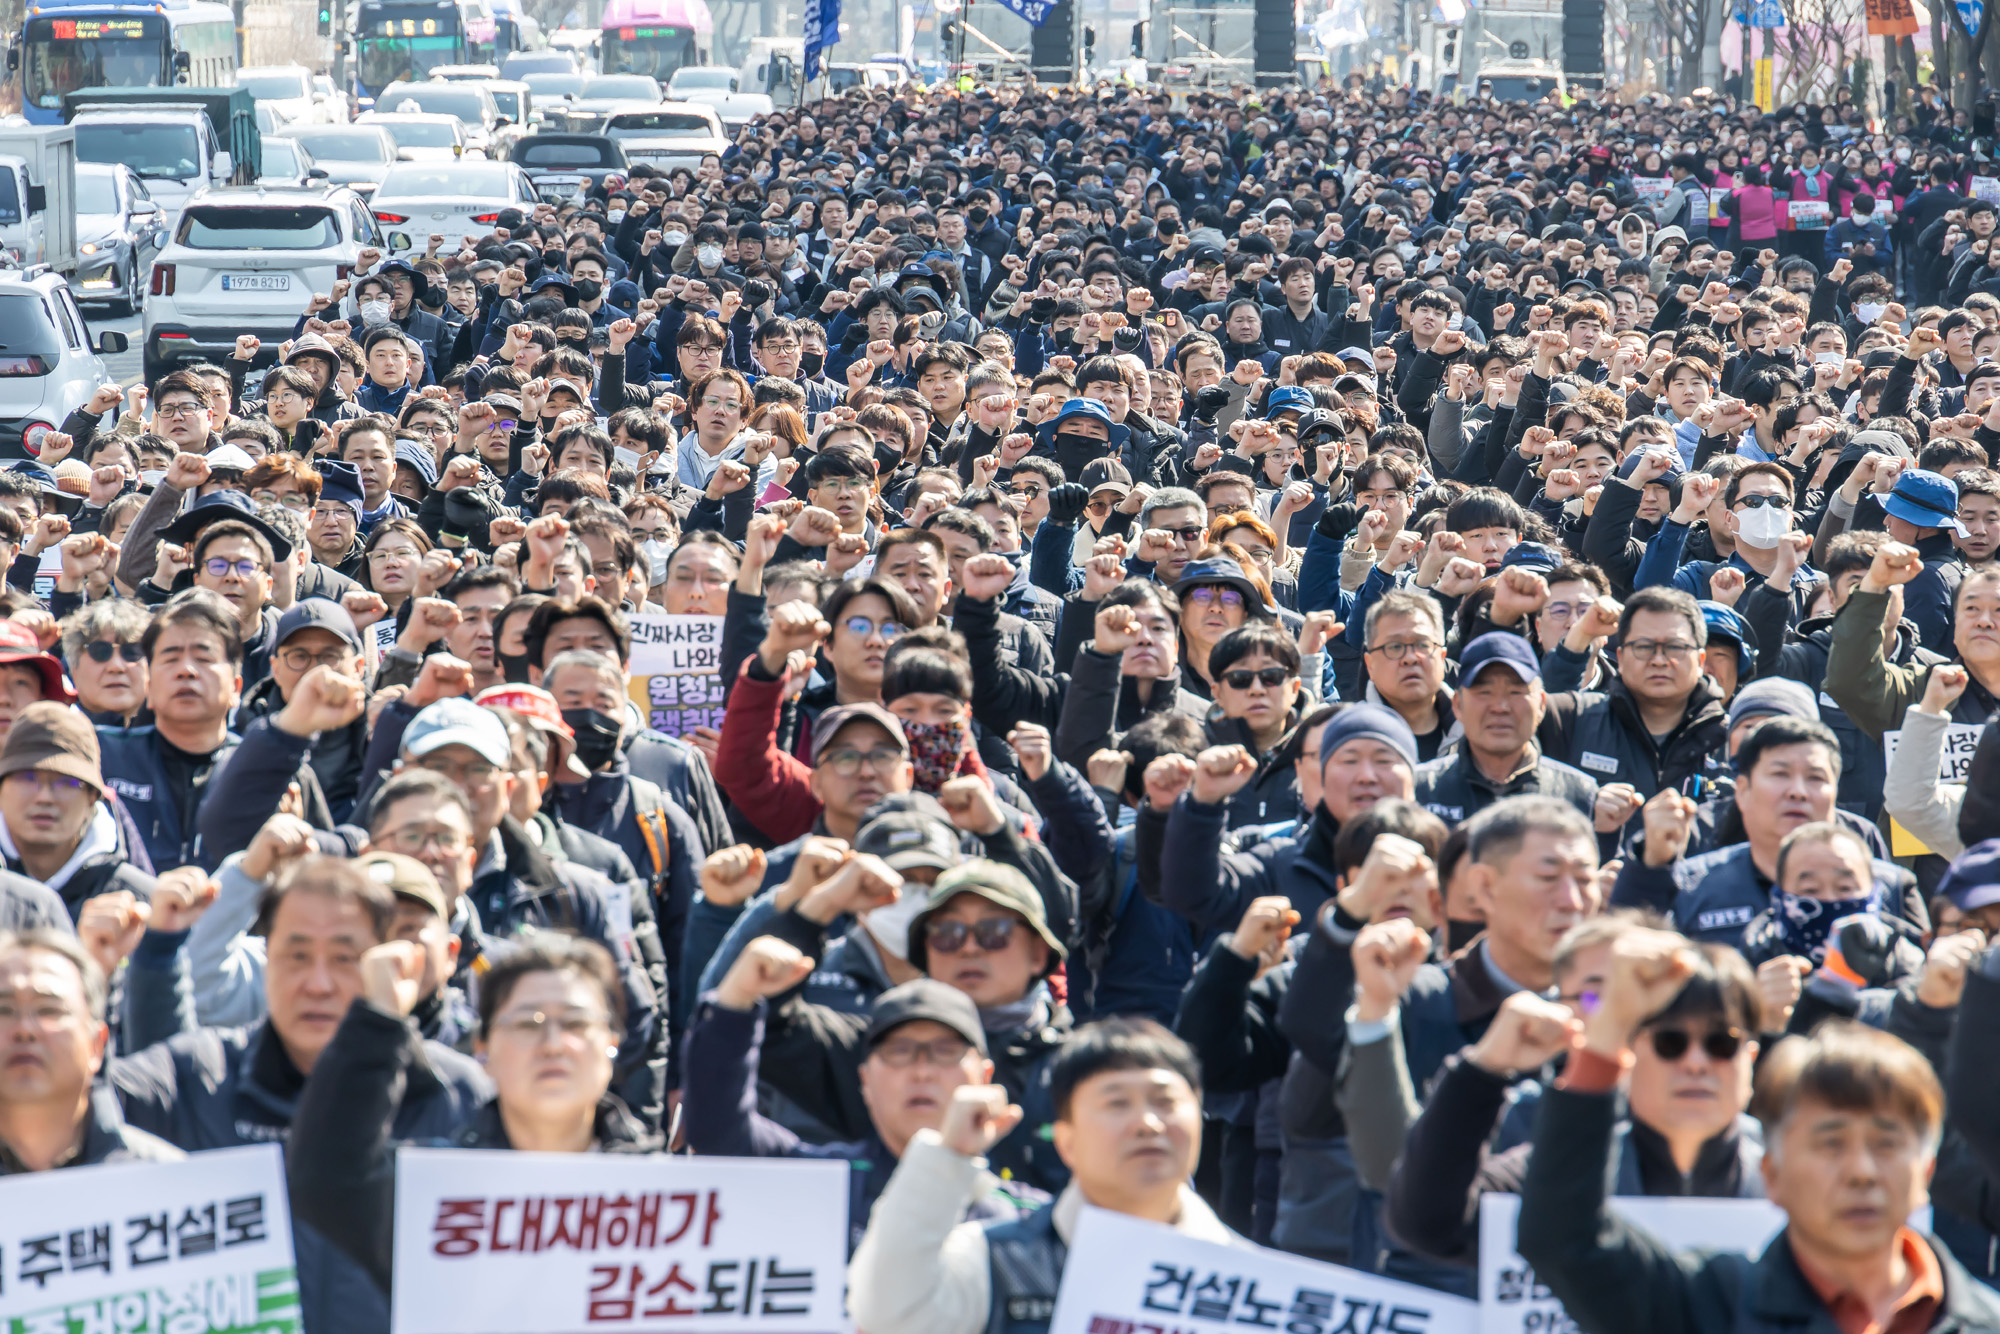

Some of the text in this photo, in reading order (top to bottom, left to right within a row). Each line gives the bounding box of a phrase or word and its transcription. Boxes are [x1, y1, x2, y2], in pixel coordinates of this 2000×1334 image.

[385, 18, 435, 37] 150
[260, 277, 287, 289] 8219
[630, 621, 717, 644] 진짜사장
[673, 647, 718, 668] 나와
[433, 1190, 721, 1256] 중대재해가
[20, 1195, 267, 1288] 주택 건설로
[588, 1259, 815, 1321] 감소되는
